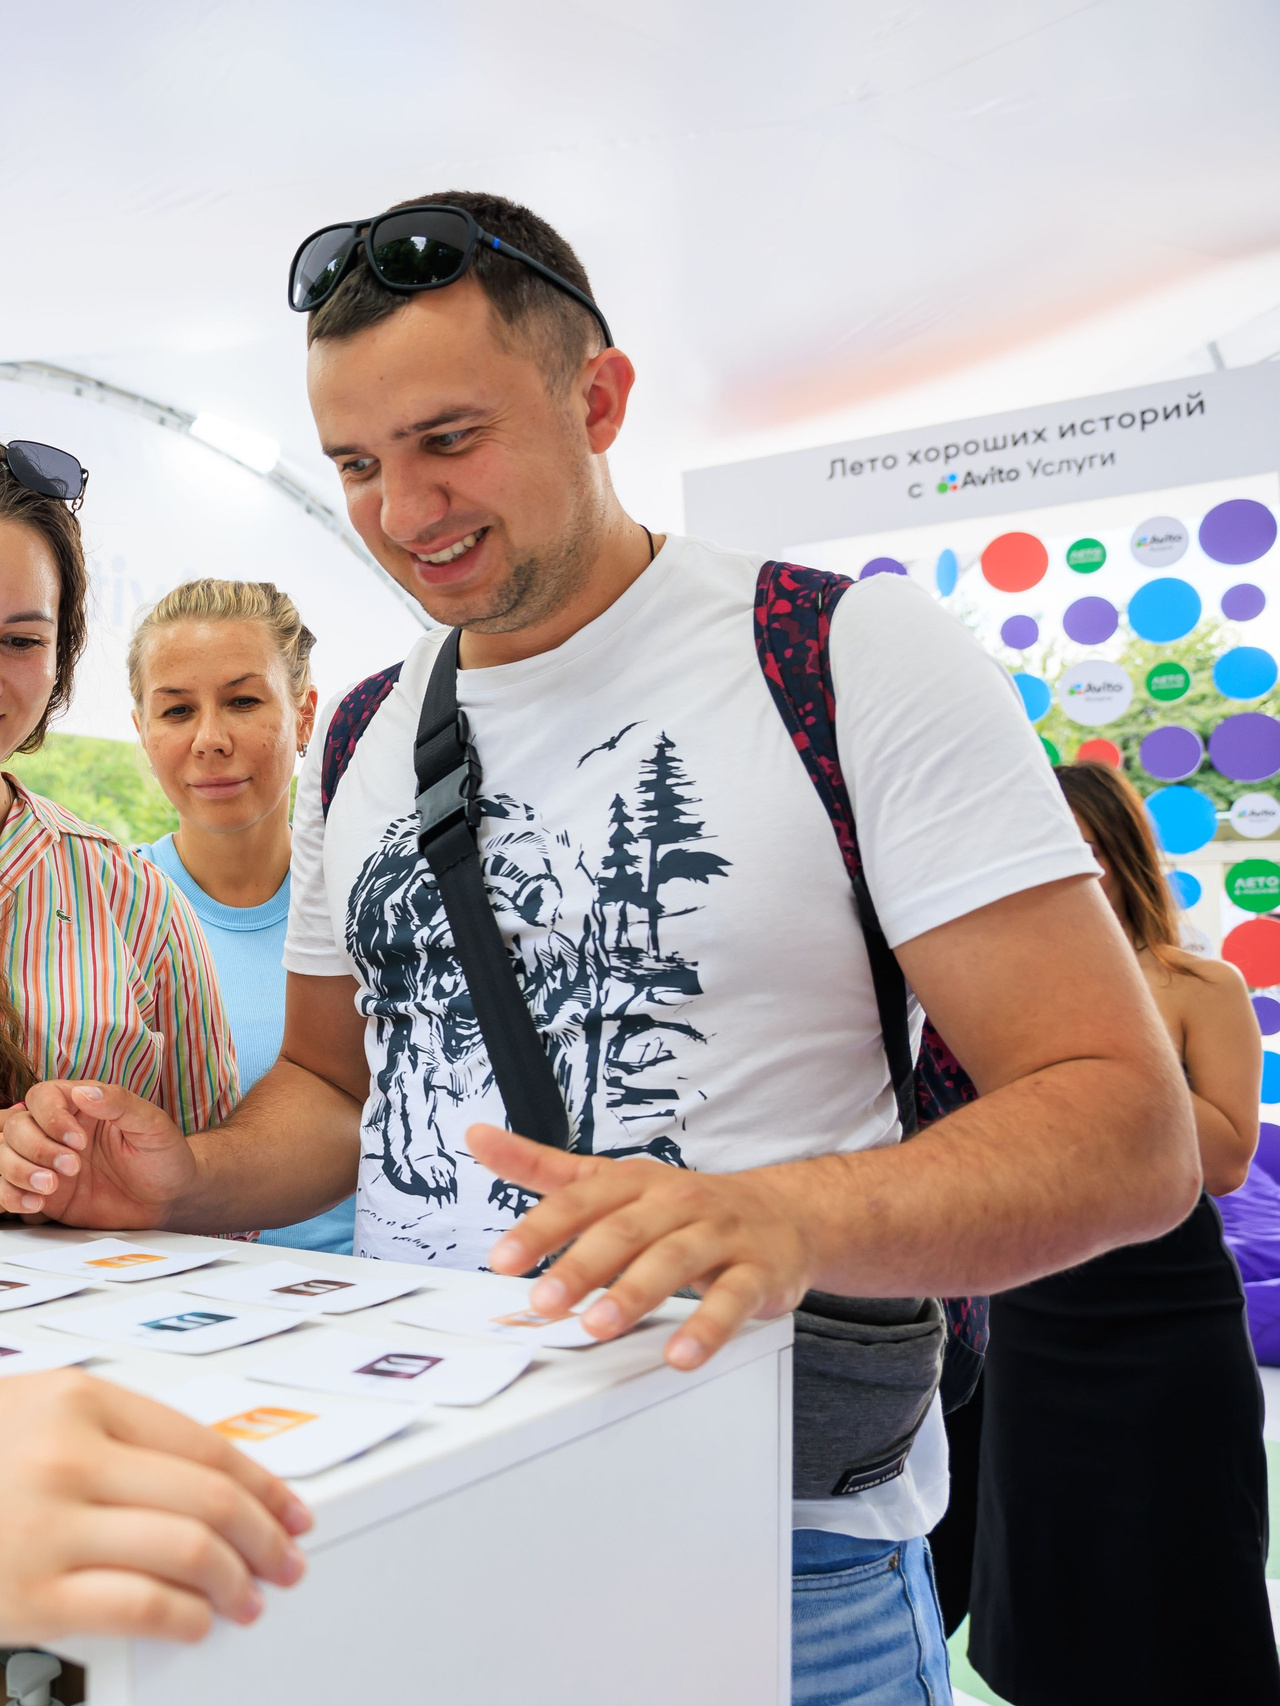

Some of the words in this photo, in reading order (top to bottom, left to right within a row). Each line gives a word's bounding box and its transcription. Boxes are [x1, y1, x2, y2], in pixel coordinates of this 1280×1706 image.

[827, 453, 898, 481] Лето
[907, 426, 1048, 465] хороших
[1057, 390, 1206, 440] историй
[907, 482, 924, 499] с
[960, 464, 1020, 490] Avito
[1025, 449, 1117, 480] Услуги
[1084, 680, 1123, 693] Avito
